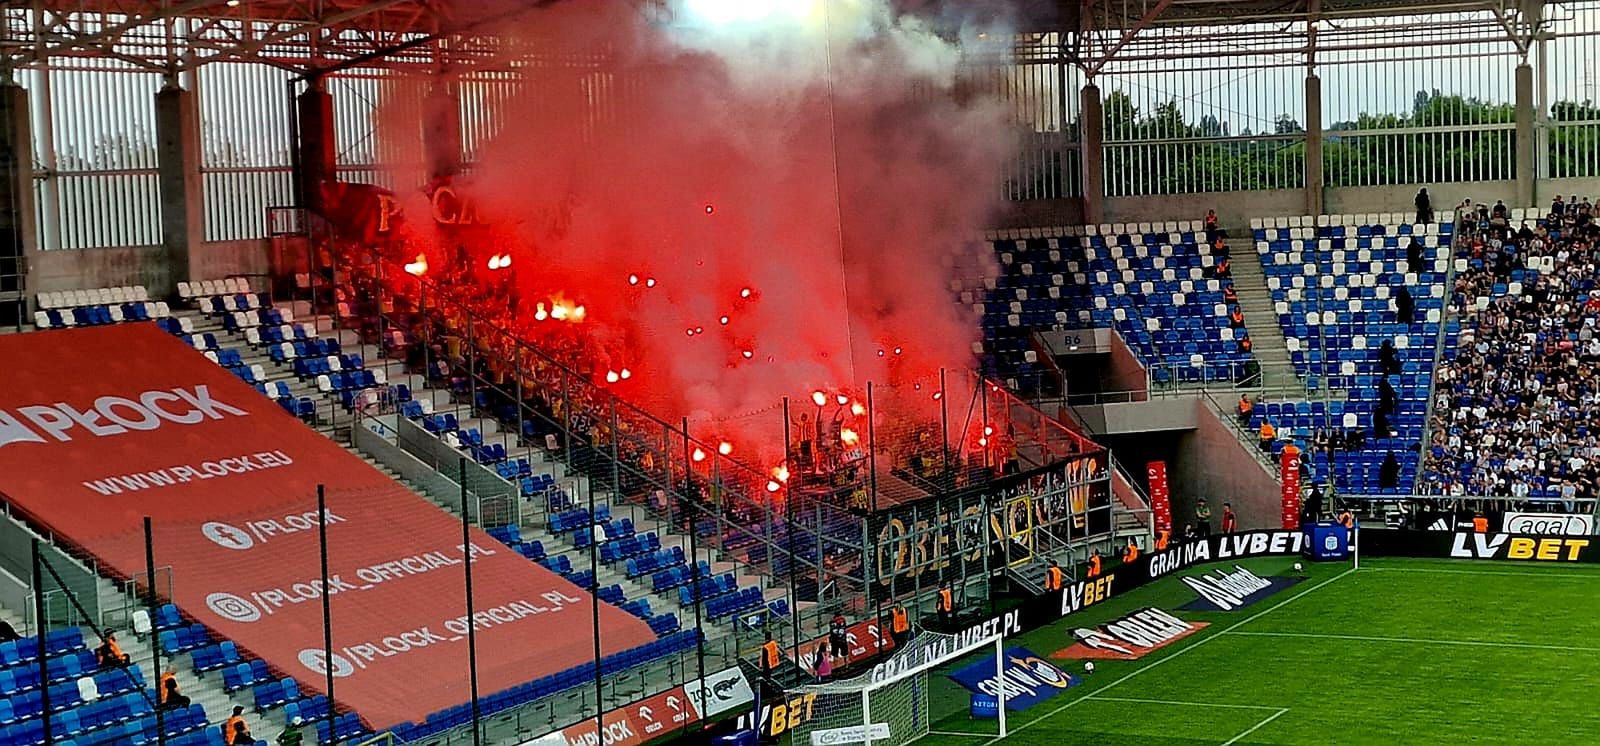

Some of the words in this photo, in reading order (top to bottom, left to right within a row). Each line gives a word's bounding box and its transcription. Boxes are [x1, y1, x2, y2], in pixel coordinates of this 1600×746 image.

[17, 384, 249, 442] PŁOCK
[83, 450, 293, 495] WWW.PLOCK.EU
[1150, 546, 1181, 577] GRAJ
[1184, 540, 1210, 565] NA
[1450, 532, 1590, 561] LVBET
[1061, 574, 1115, 616] LVBET
[1107, 607, 1195, 648] ORLEN
